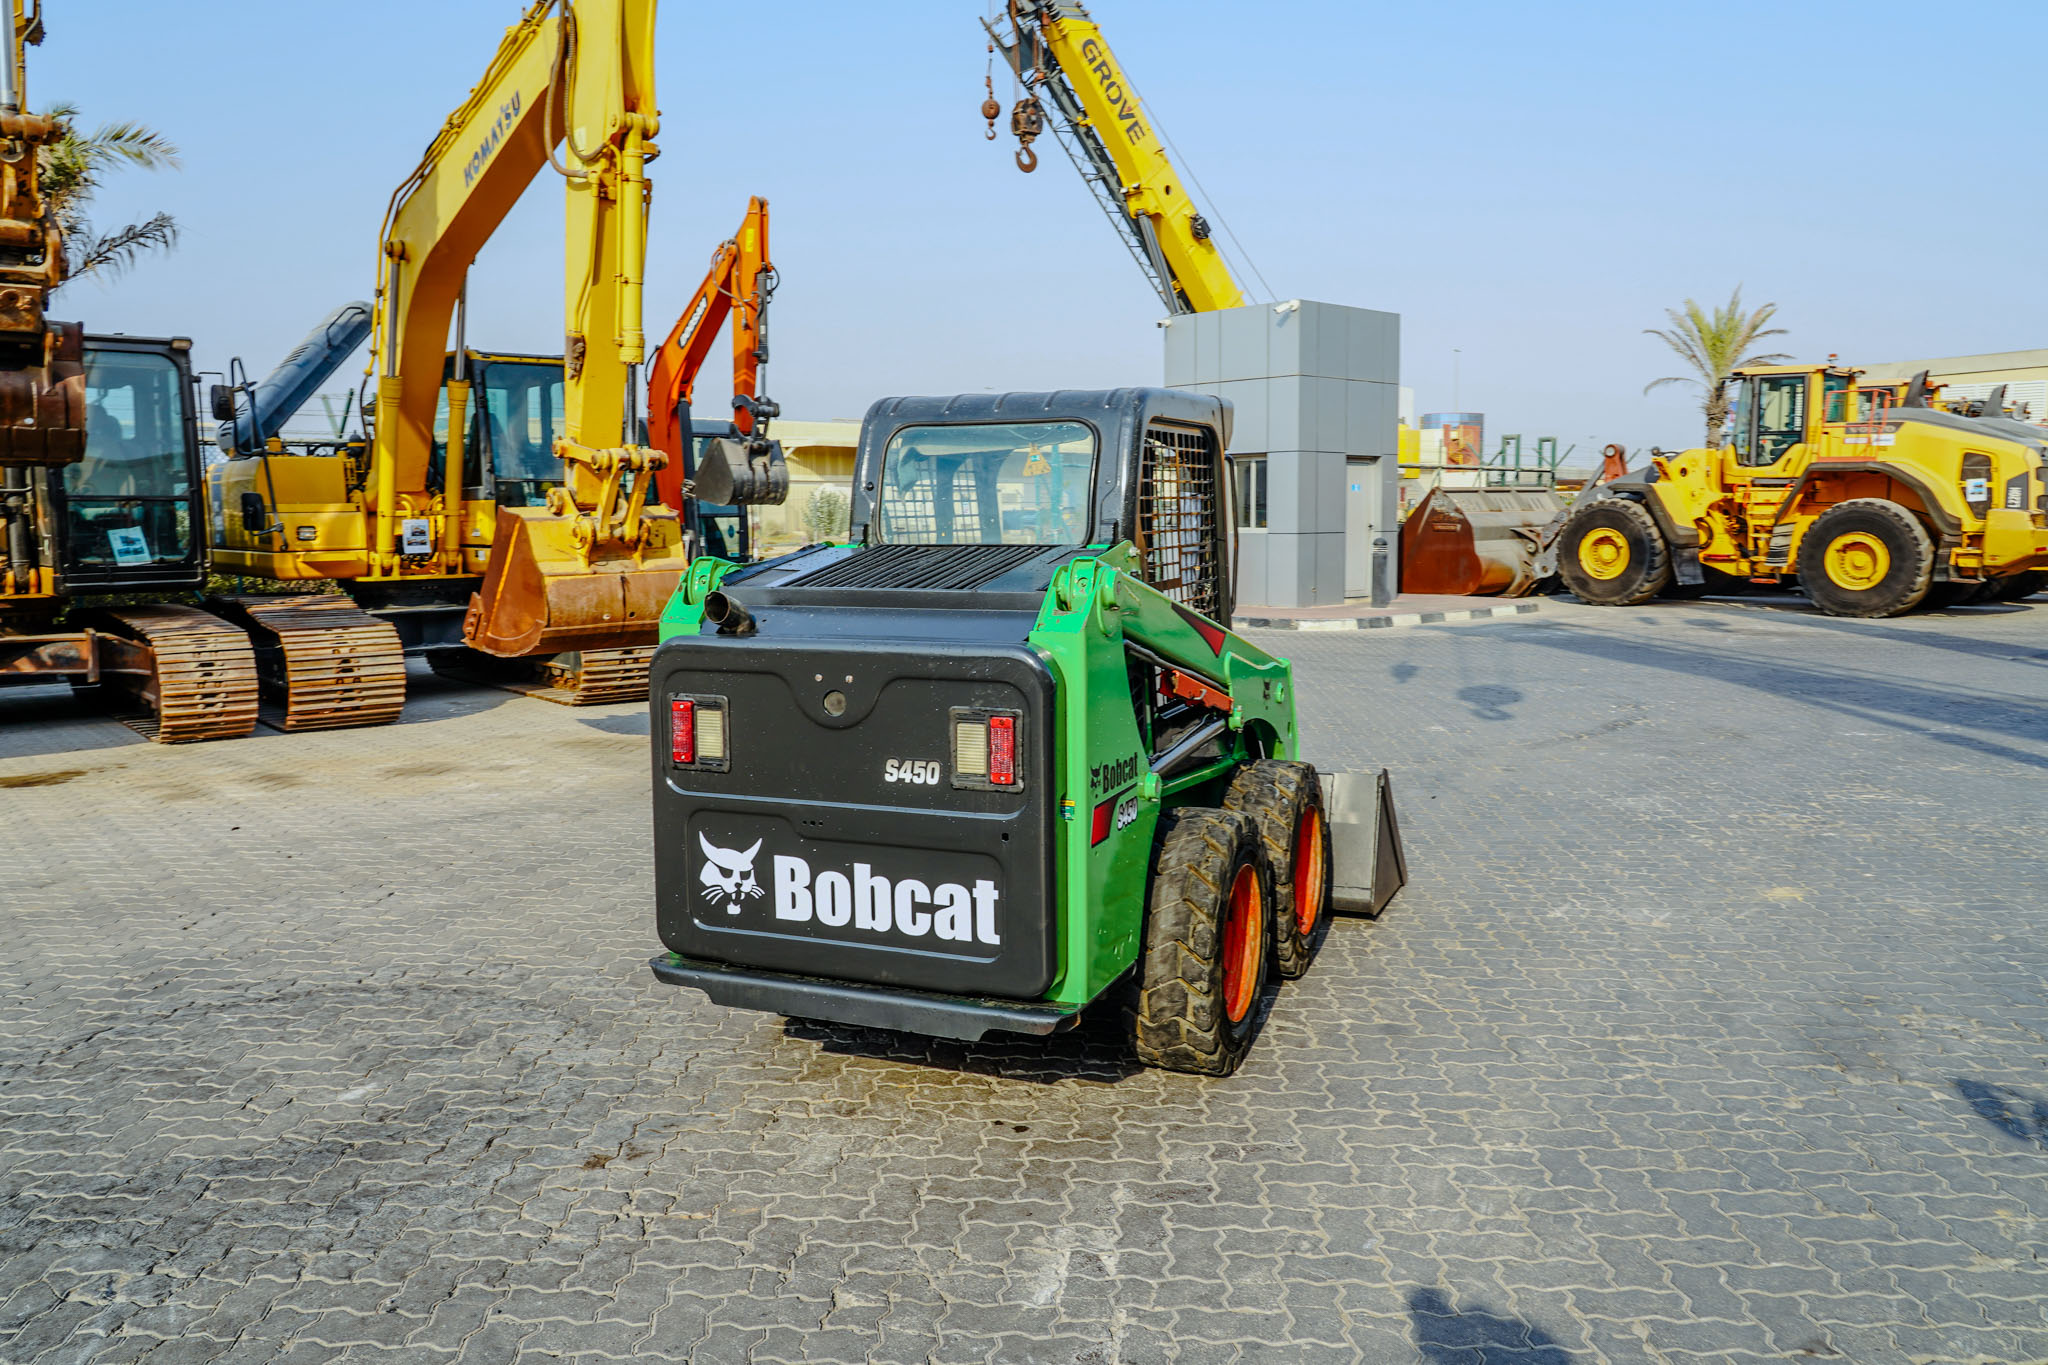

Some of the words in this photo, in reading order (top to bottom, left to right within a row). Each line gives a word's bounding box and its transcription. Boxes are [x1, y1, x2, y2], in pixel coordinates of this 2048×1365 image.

[1082, 39, 1146, 146] GROVE
[464, 88, 521, 188] KOMATSU
[884, 758, 941, 785] S450
[1103, 752, 1138, 794] Bobcat
[773, 855, 1001, 945] Bobcat
